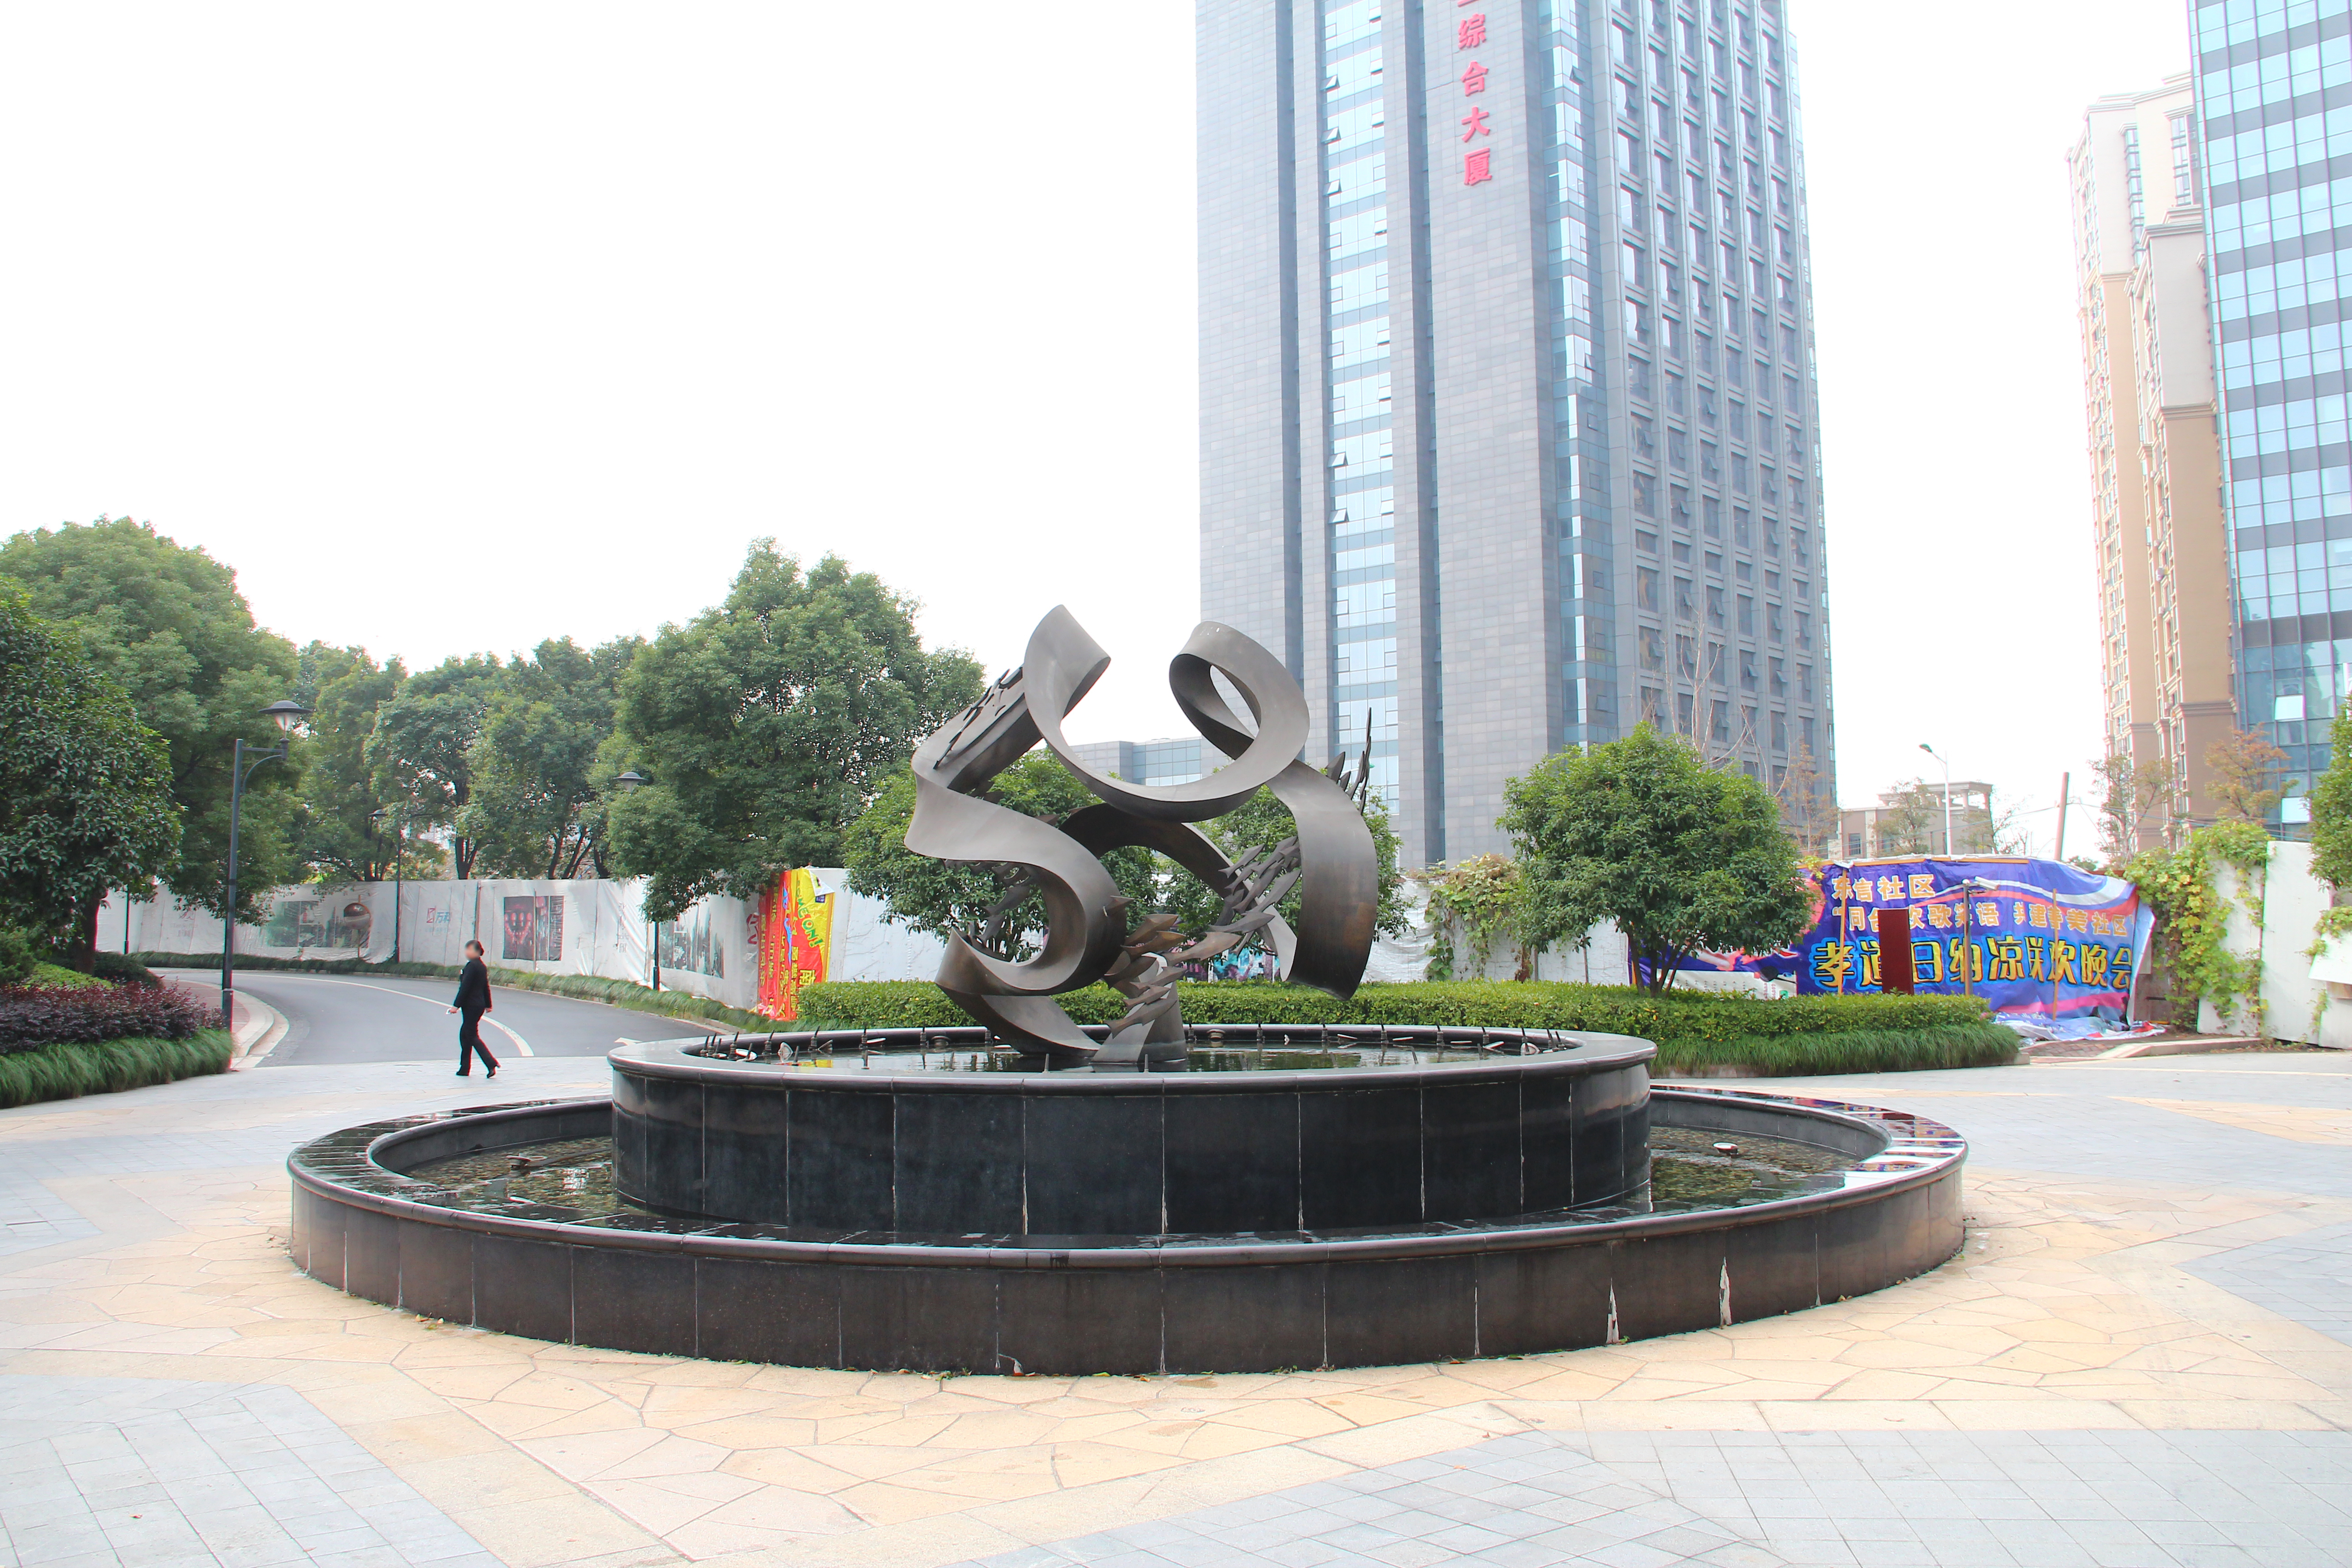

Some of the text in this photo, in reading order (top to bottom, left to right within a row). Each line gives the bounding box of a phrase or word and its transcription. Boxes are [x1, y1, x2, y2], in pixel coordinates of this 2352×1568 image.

[1457, 0, 1492, 186] 综合大厦
[1831, 874, 1936, 902] 东信社区
